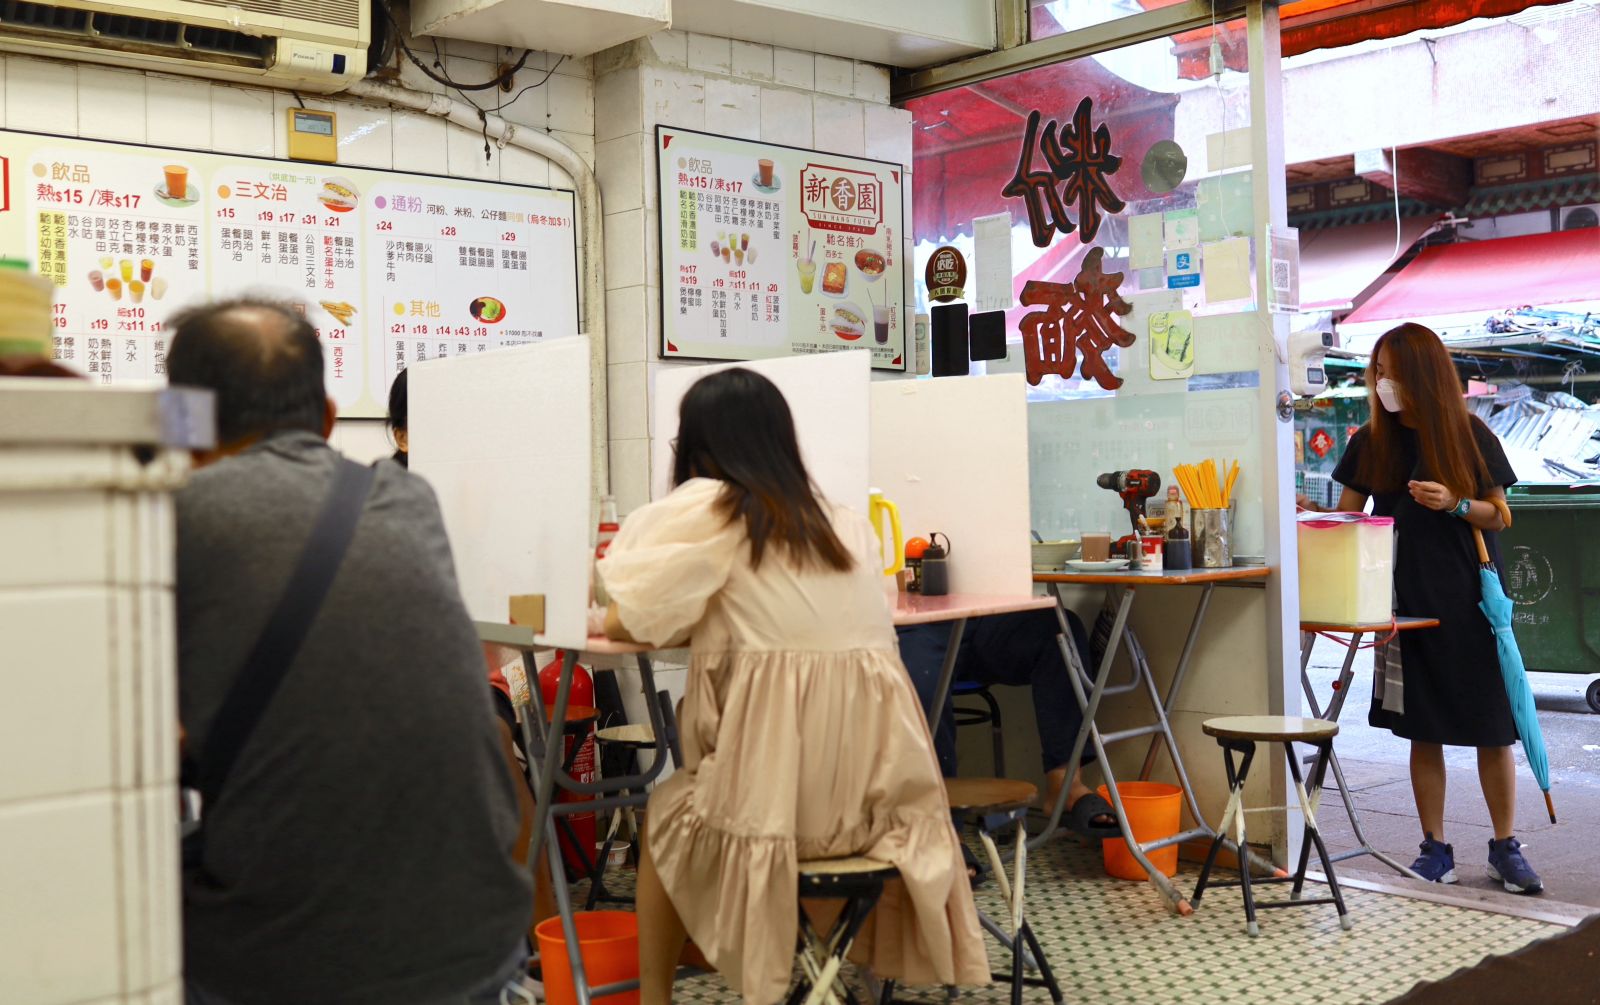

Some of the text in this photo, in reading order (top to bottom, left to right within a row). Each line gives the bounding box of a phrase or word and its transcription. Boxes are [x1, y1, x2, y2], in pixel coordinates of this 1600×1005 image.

[51, 161, 90, 184] 飲品
[688, 157, 712, 175] 飲品
[678, 172, 707, 188] 熱$15
[37, 183, 83, 204] 熱$15
[235, 180, 288, 202] 三文治
[804, 172, 877, 216] 新香園
[392, 194, 422, 214] 通粉
[697, 192, 705, 211] 奶水
[714, 195, 722, 223] 阿華田
[722, 196, 730, 224] 好立克
[217, 208, 235, 218] $15
[258, 211, 273, 221] $19
[280, 213, 295, 223] $17
[302, 214, 316, 225] $31
[324, 216, 340, 227] $21
[813, 212, 827, 220] SUN
[68, 215, 79, 239] 奶水
[82, 216, 92, 240] 谷咕
[95, 217, 106, 252] 阿華田
[376, 220, 392, 231] $24
[440, 226, 456, 236] $28
[108, 218, 120, 254] 好立克
[122, 220, 134, 254] 杏仁霜
[136, 220, 146, 256] 檸檬茶
[149, 222, 160, 256] 檸檬水
[162, 223, 172, 257] 滾水蛋
[175, 224, 186, 247] 鮮奶
[221, 228, 231, 250] 蛋治
[502, 232, 516, 242] $29
[826, 233, 865, 249] 馳名推介
[188, 224, 198, 270] 西洋菜蜜
[261, 230, 272, 264] 鮮牛治
[305, 234, 316, 288] 公司三文治
[52, 304, 66, 314] 17
[410, 300, 441, 318] 其他
[734, 292, 741, 311] 汽水
[52, 317, 67, 328] 19
[91, 319, 108, 330] $19
[391, 324, 406, 333] $21
[413, 324, 428, 334] $18
[436, 326, 450, 335] $14
[454, 326, 470, 336] $43
[474, 327, 487, 336] $18
[329, 328, 345, 339] $21
[88, 338, 99, 373] 奶水蛋
[126, 339, 137, 362] 汽水
[334, 346, 344, 378] 西多士
